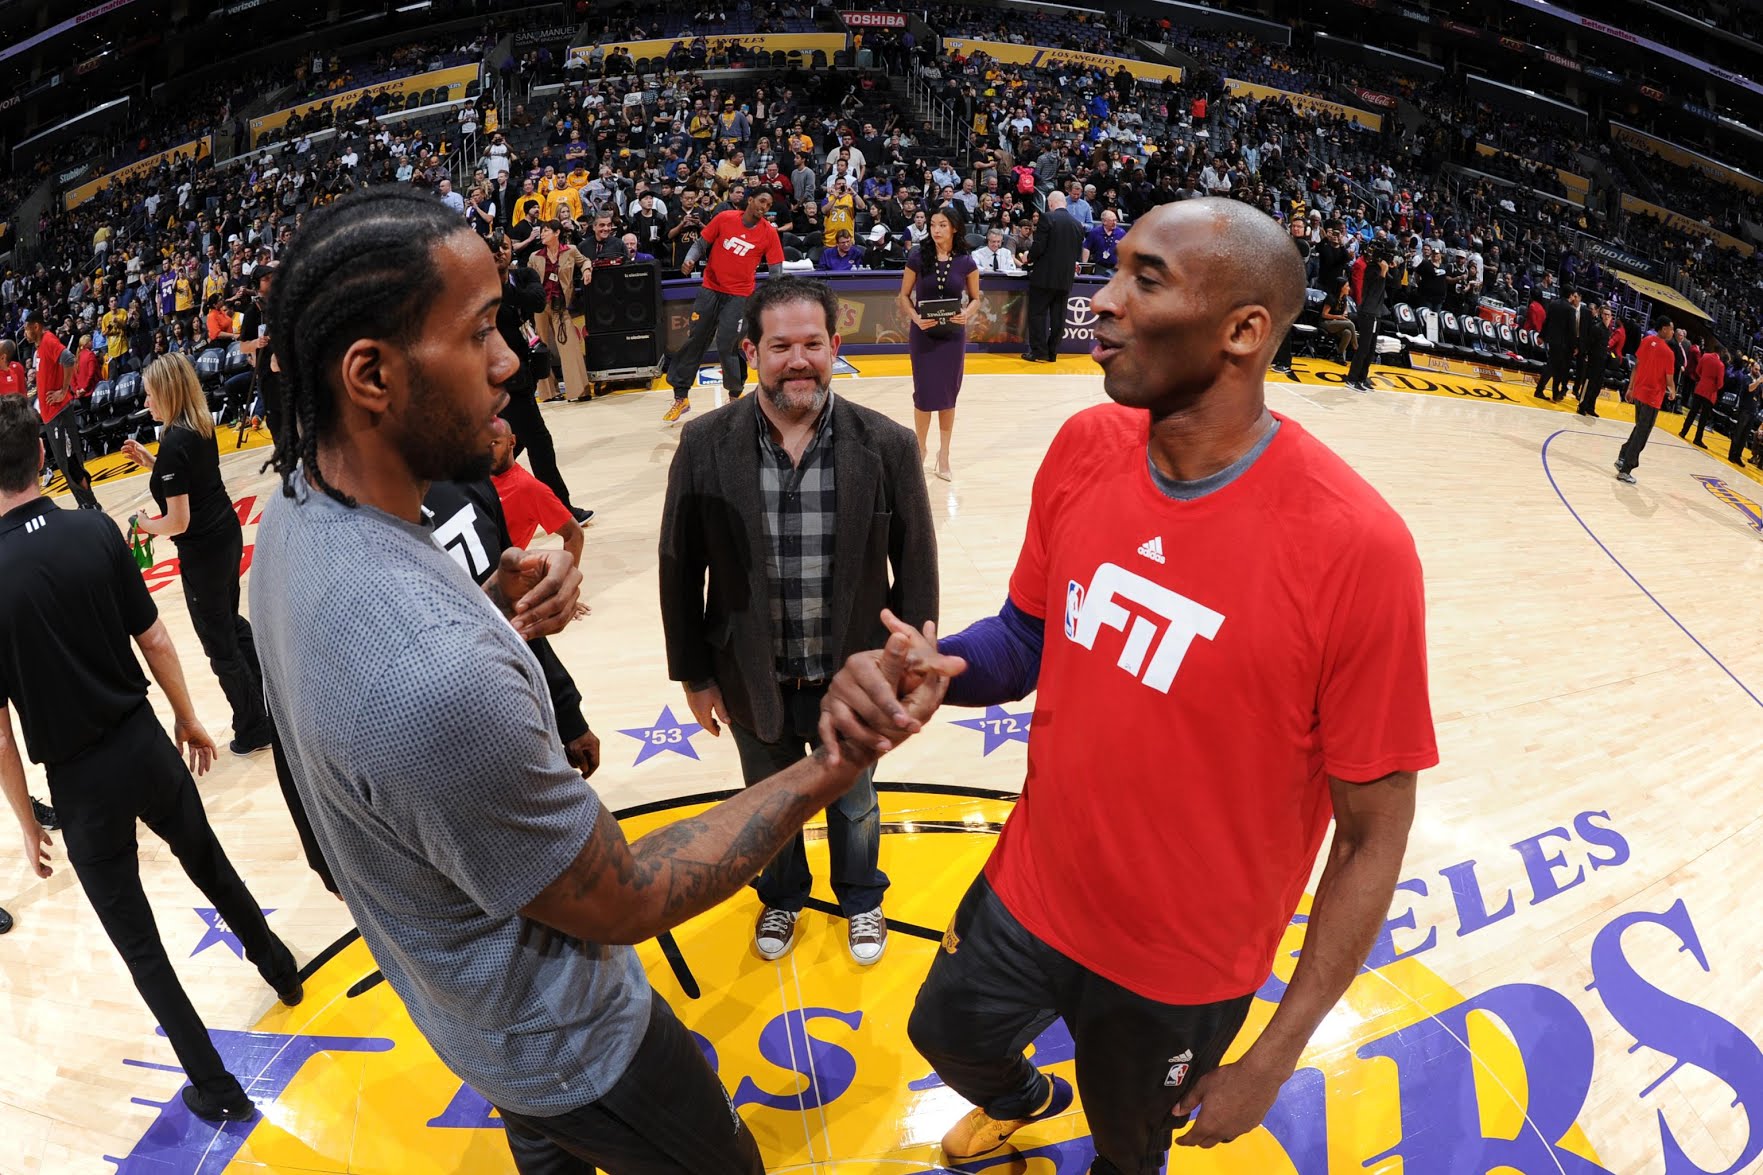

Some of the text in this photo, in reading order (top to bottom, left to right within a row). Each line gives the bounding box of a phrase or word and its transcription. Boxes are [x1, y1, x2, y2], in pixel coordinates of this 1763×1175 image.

[228, 0, 260, 15] verizon
[842, 14, 905, 26] TOSHIBA
[1581, 17, 1606, 31] Better
[515, 26, 577, 42] SAN MANUEL
[1071, 53, 1116, 66] ANGELES
[1544, 53, 1582, 71] TOSHIBA
[340, 93, 357, 102] LOS
[831, 211, 846, 222] 24
[725, 237, 756, 256] FIT
[1591, 243, 1653, 271] BUD LIGHT
[1062, 328, 1098, 340] OYOT
[120, 380, 135, 390] DELTA
[96, 389, 111, 397] DELTA
[1137, 546, 1166, 565] adidas
[1076, 562, 1226, 694] FIT
[978, 718, 1022, 735] '72
[644, 728, 683, 745] '53
[213, 913, 233, 933] '4
